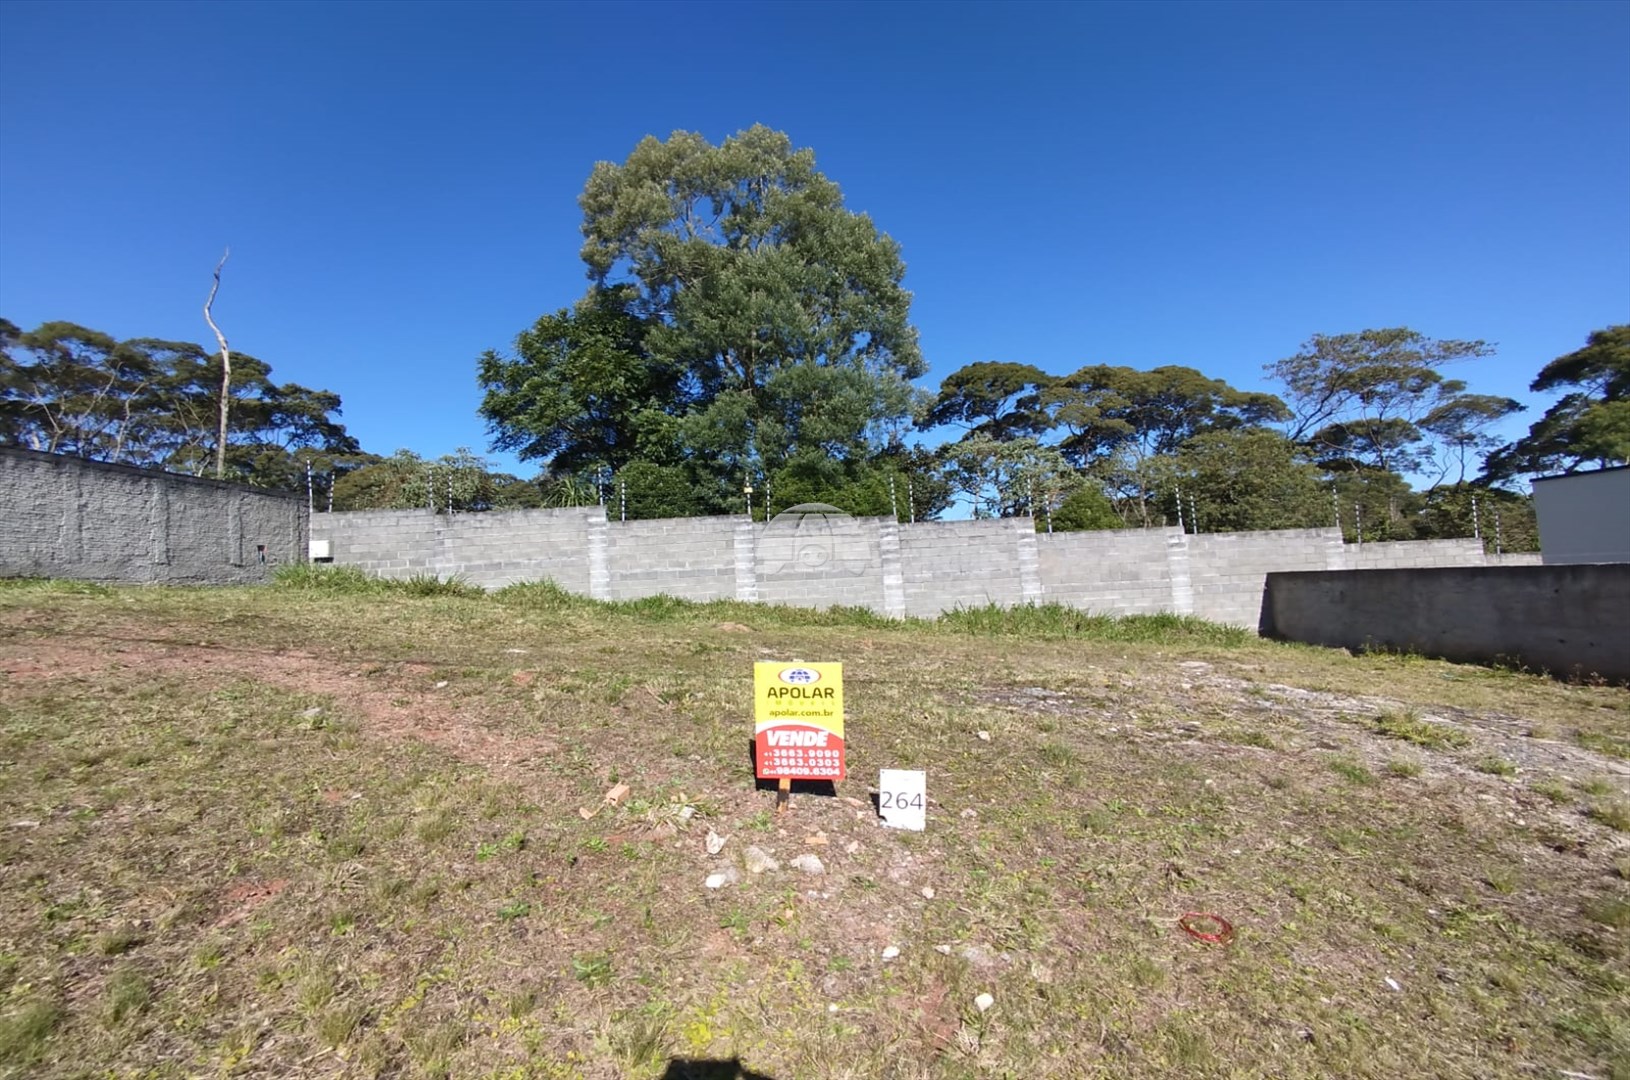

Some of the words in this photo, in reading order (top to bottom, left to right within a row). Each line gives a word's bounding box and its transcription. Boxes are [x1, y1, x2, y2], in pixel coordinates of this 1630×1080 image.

[767, 687, 834, 699] APOLAR
[769, 708, 833, 717] apolar.com.br
[766, 730, 828, 747] VENDE
[773, 758, 840, 767] 3663.0303
[881, 791, 923, 810] 264
